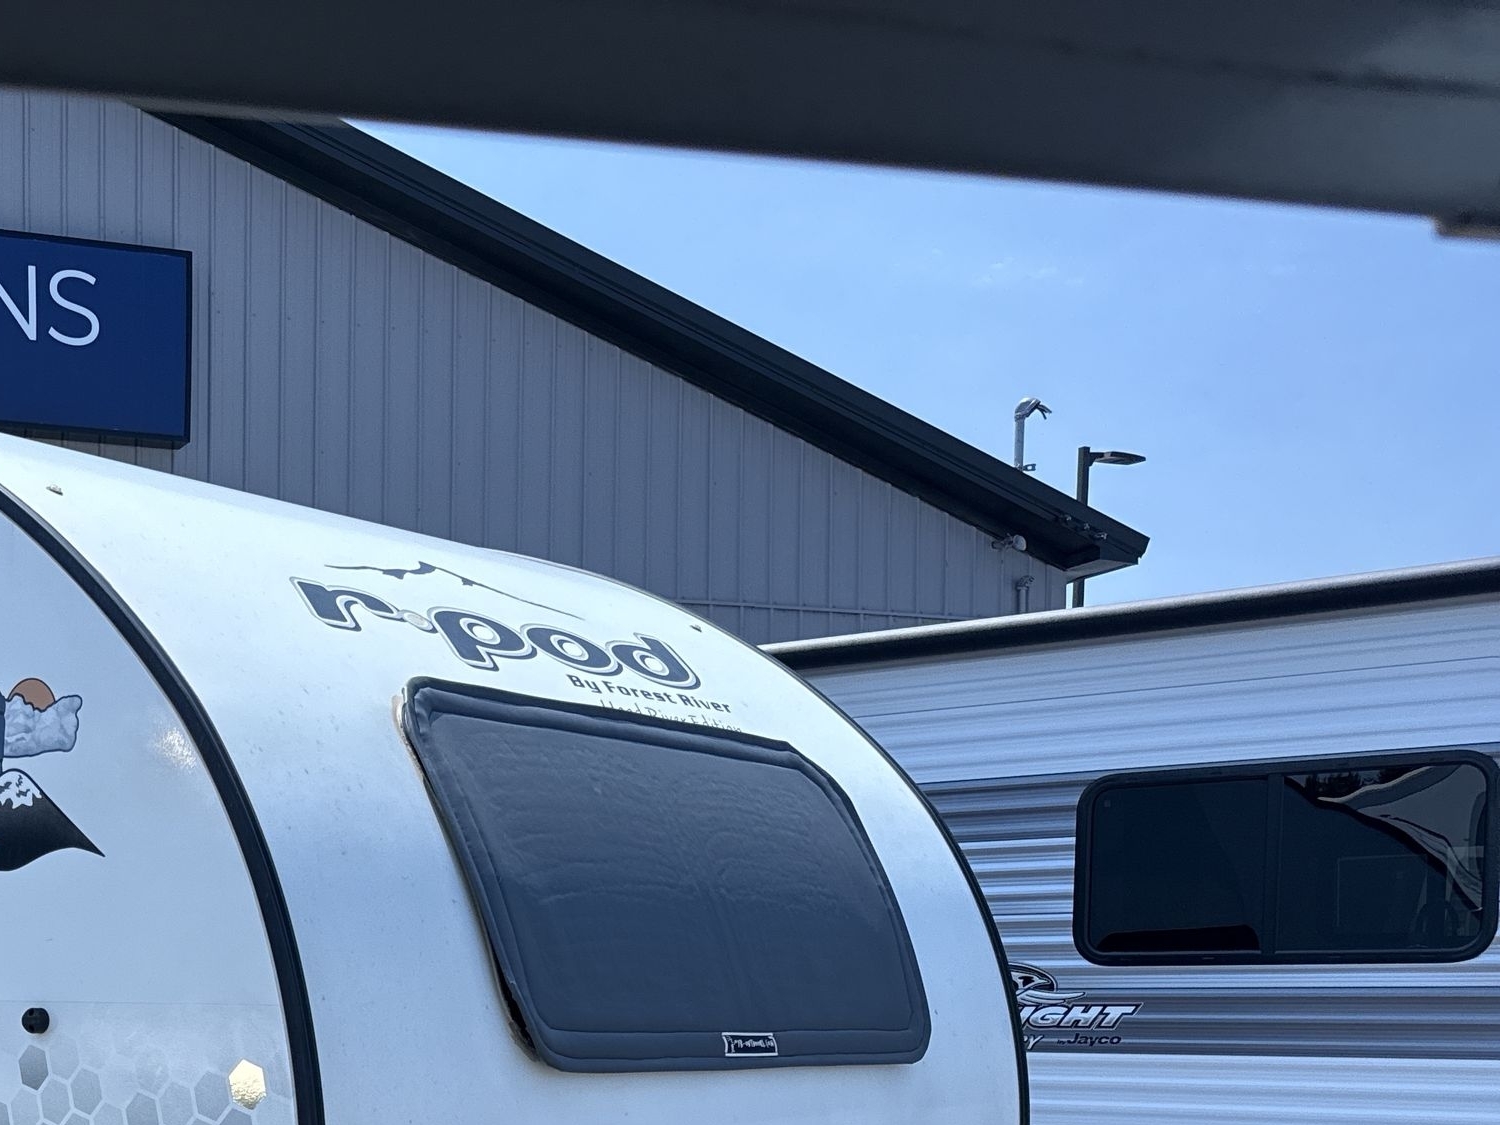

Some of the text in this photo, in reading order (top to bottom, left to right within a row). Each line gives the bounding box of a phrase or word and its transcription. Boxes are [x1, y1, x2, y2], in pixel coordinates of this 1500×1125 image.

[566, 673, 732, 713] By Forest River
[1019, 1003, 1141, 1030] IGHT
[1066, 1032, 1122, 1047] Jayco
